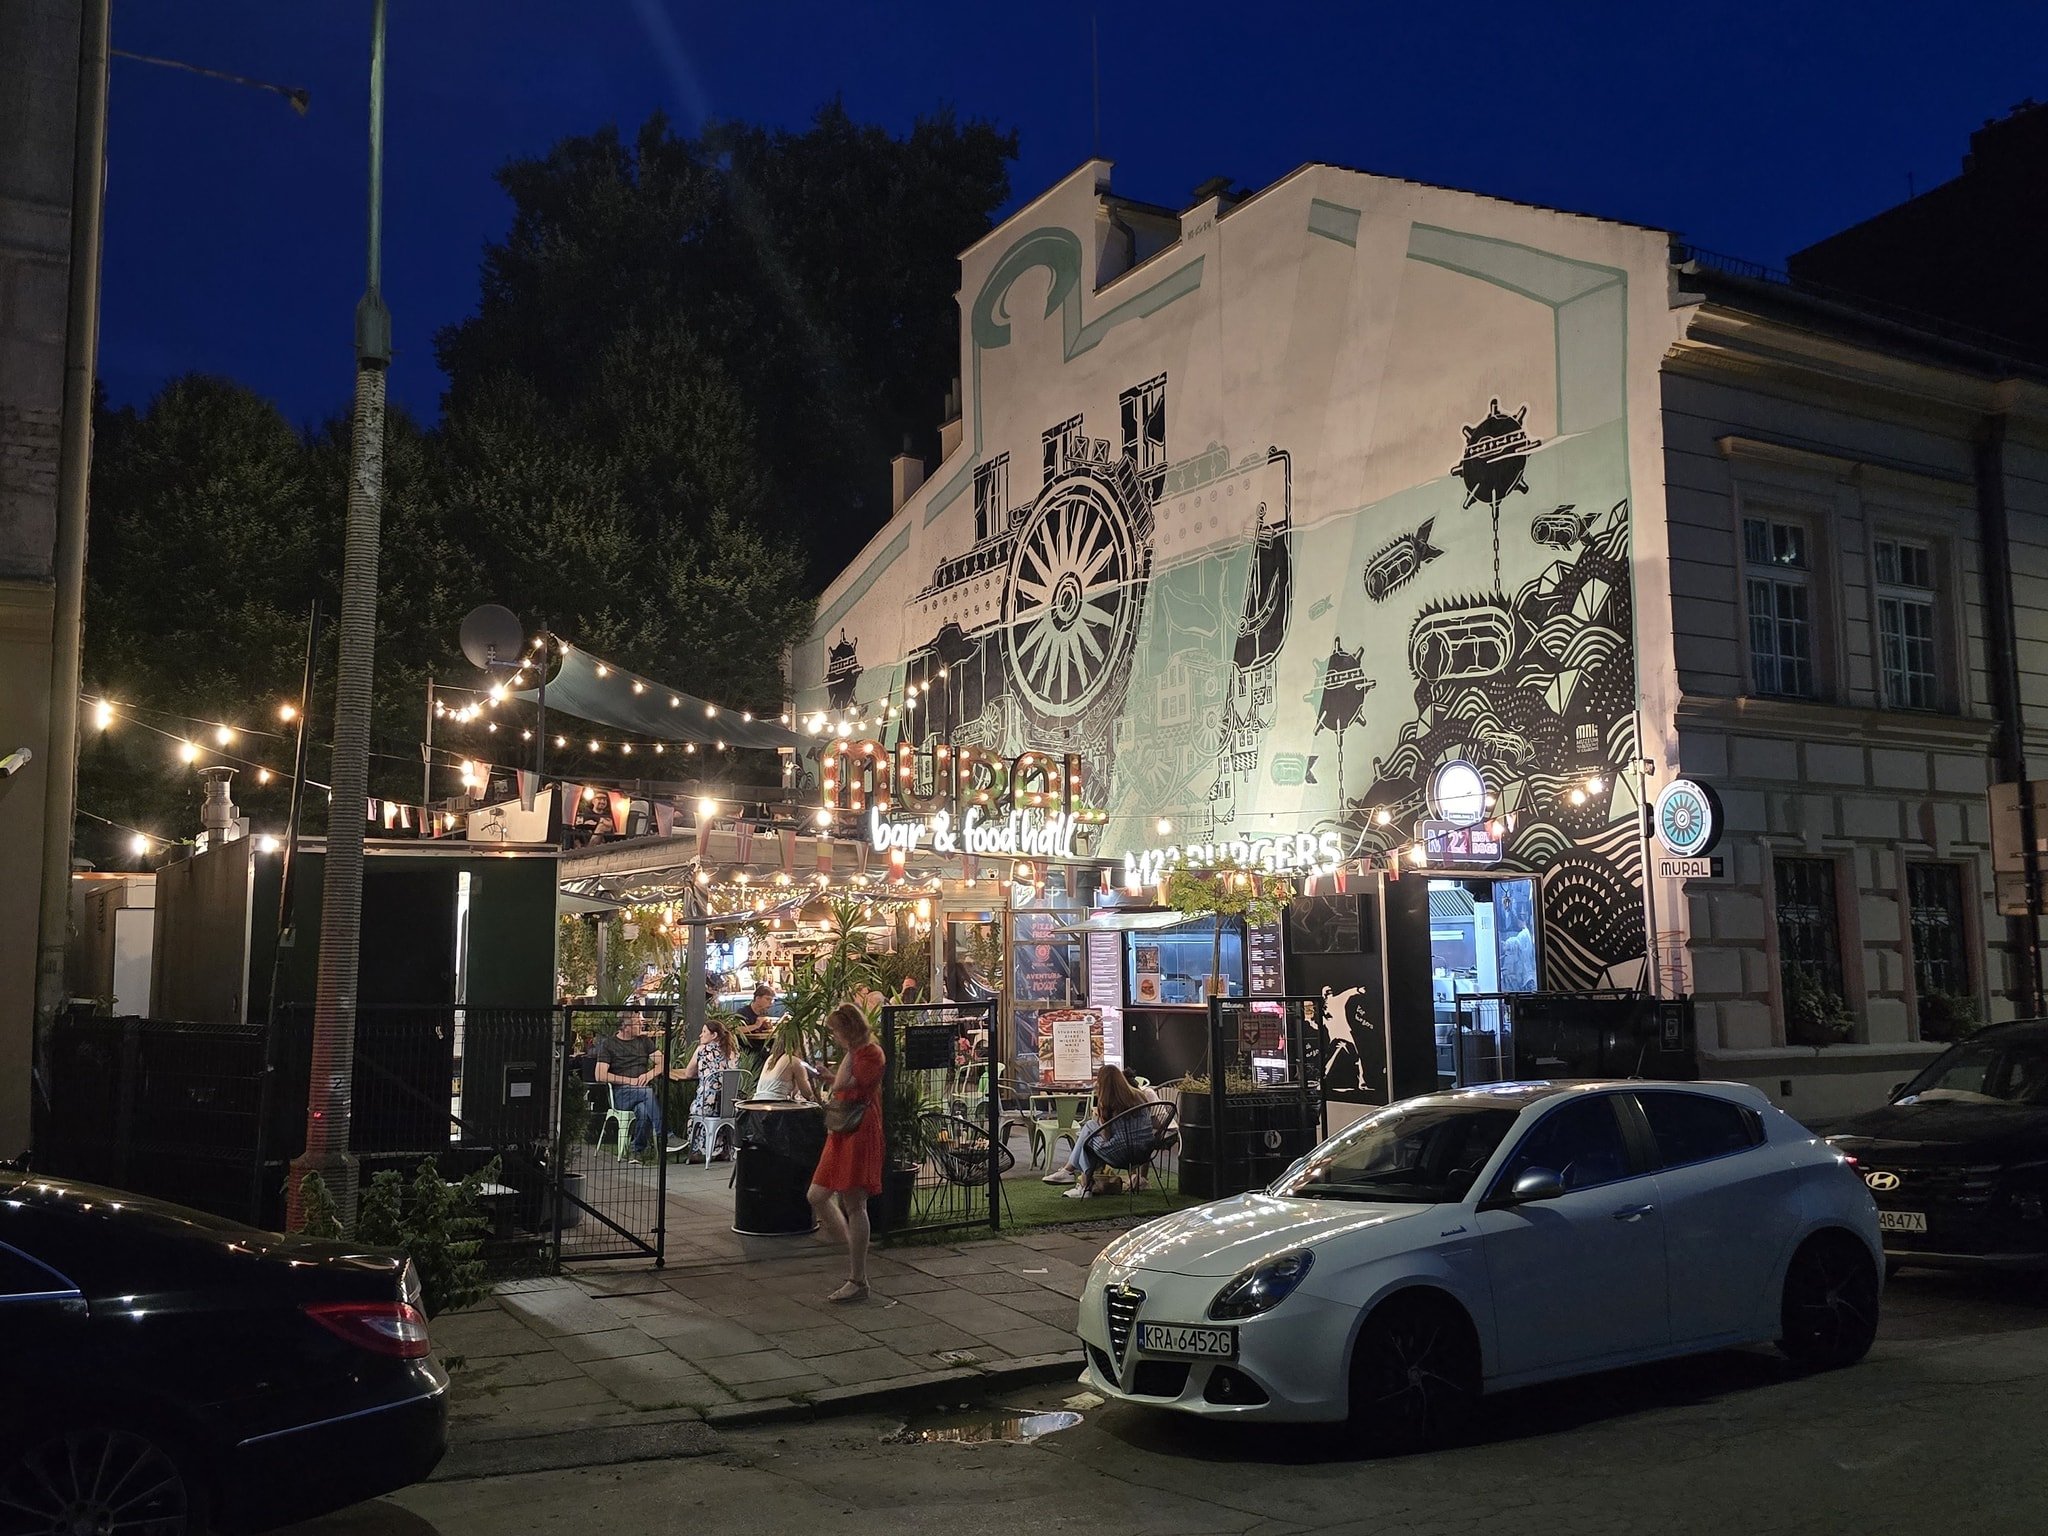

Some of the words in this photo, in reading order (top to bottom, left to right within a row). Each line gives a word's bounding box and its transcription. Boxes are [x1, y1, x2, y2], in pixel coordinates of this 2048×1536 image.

[819, 738, 1109, 825] MURAL
[869, 805, 926, 852] bar
[932, 808, 956, 852] &
[1472, 843, 1498, 854] DOGS
[1661, 861, 1709, 876] MURAL
[1145, 1326, 1173, 1350] KRA
[1178, 1329, 1230, 1354] 6452G
